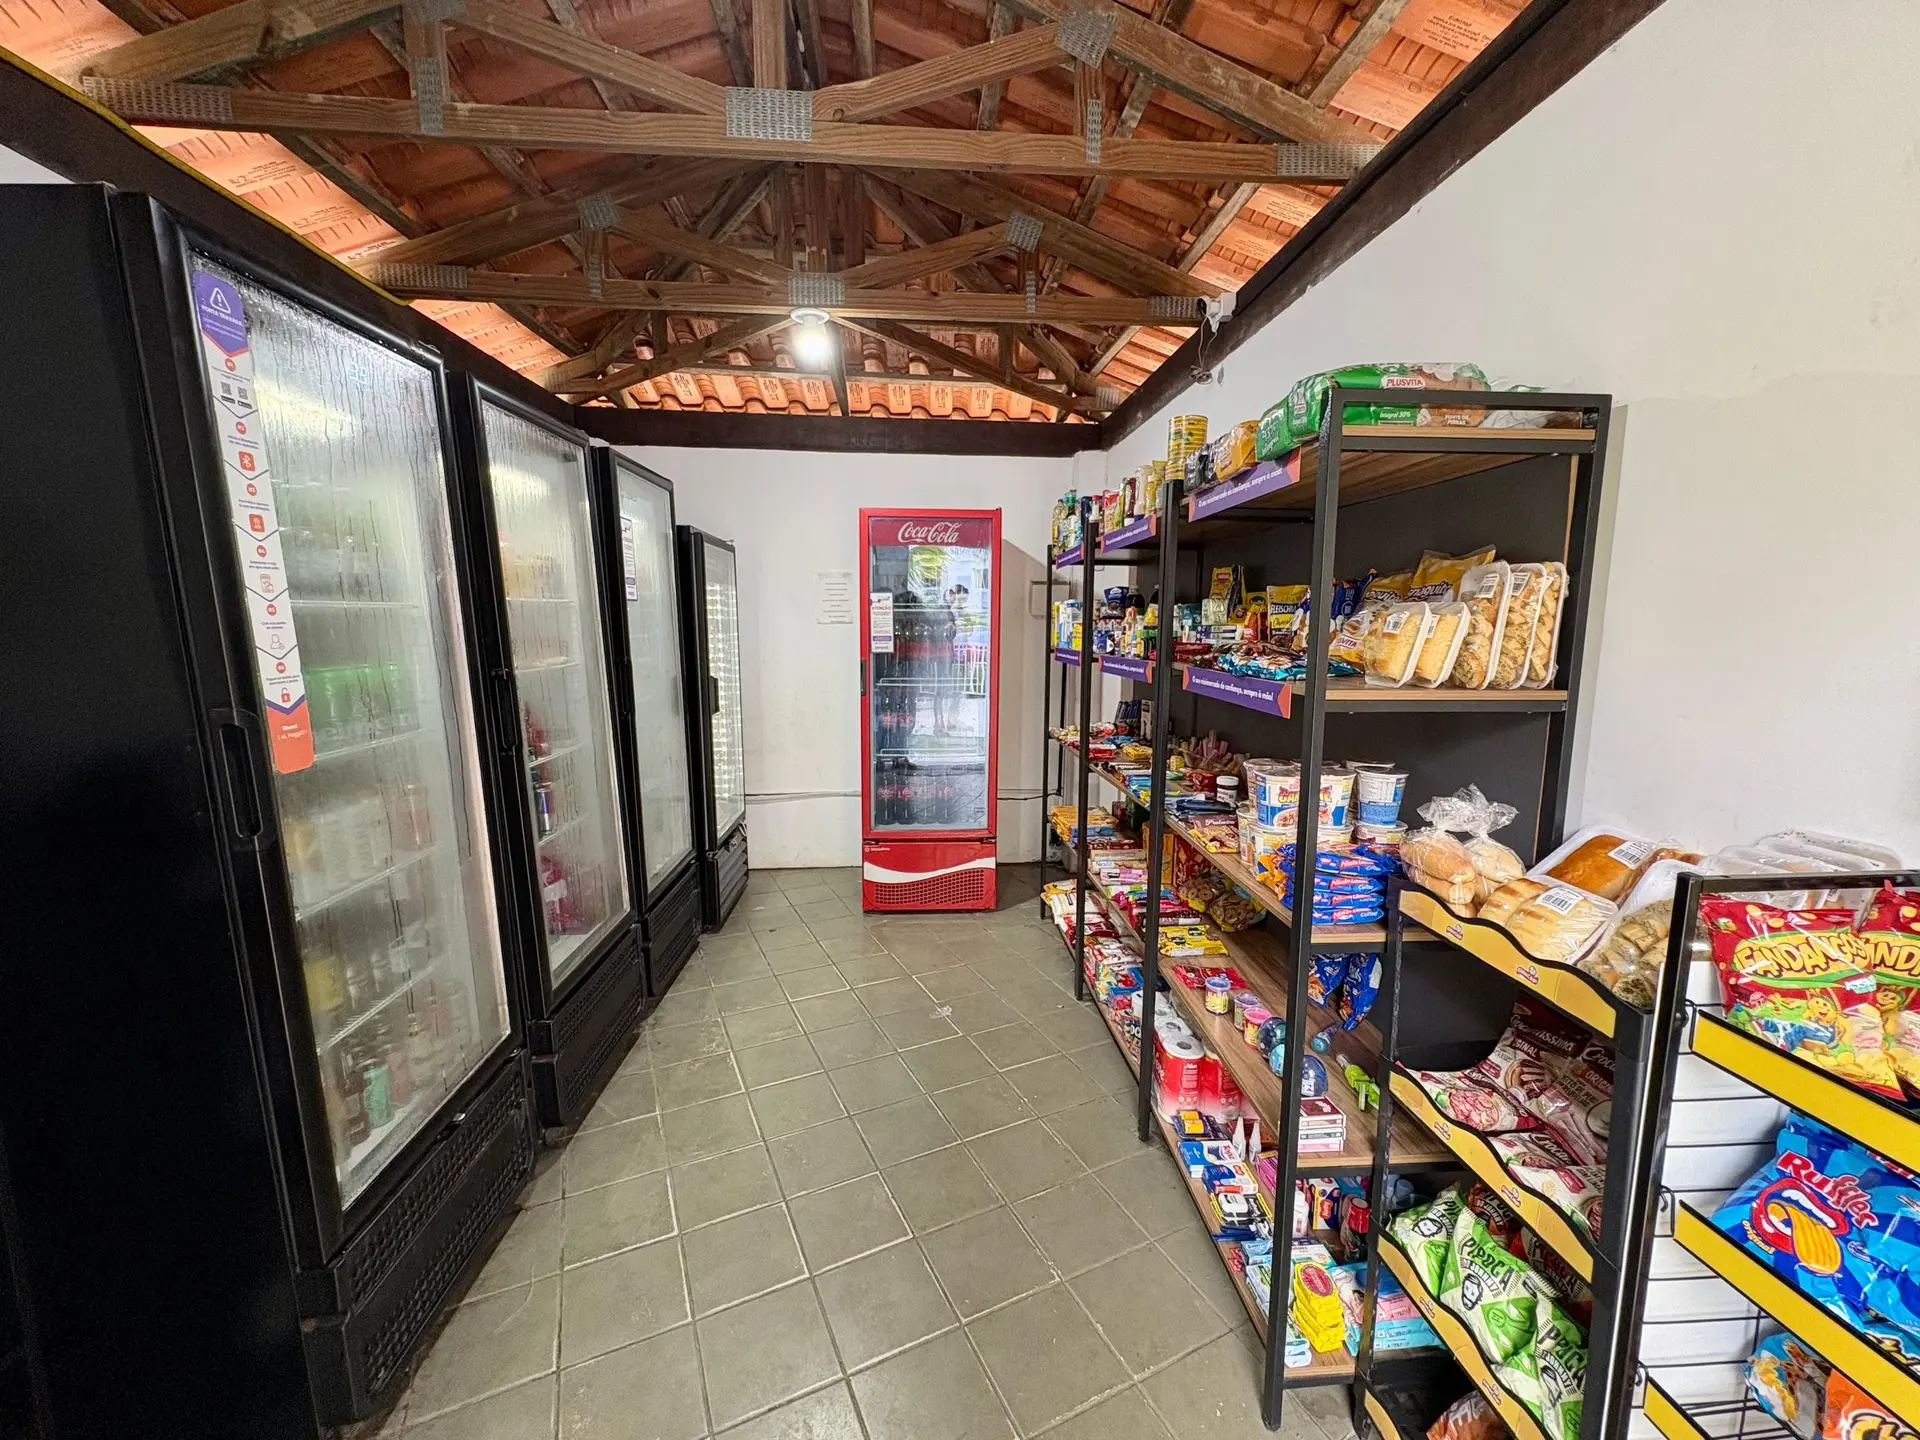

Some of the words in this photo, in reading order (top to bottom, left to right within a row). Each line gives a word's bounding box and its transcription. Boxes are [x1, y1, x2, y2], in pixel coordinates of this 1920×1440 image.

[1386, 378, 1424, 387] PLUSVITA
[898, 521, 963, 543] Coca-Cola
[1271, 604, 1297, 613] FLEISCHM
[1733, 932, 1869, 978] FANDANGOS
[1777, 1150, 1879, 1229] Ruffles
[1742, 1219, 1776, 1255] original
[1470, 1262, 1500, 1293] JOHNNY
